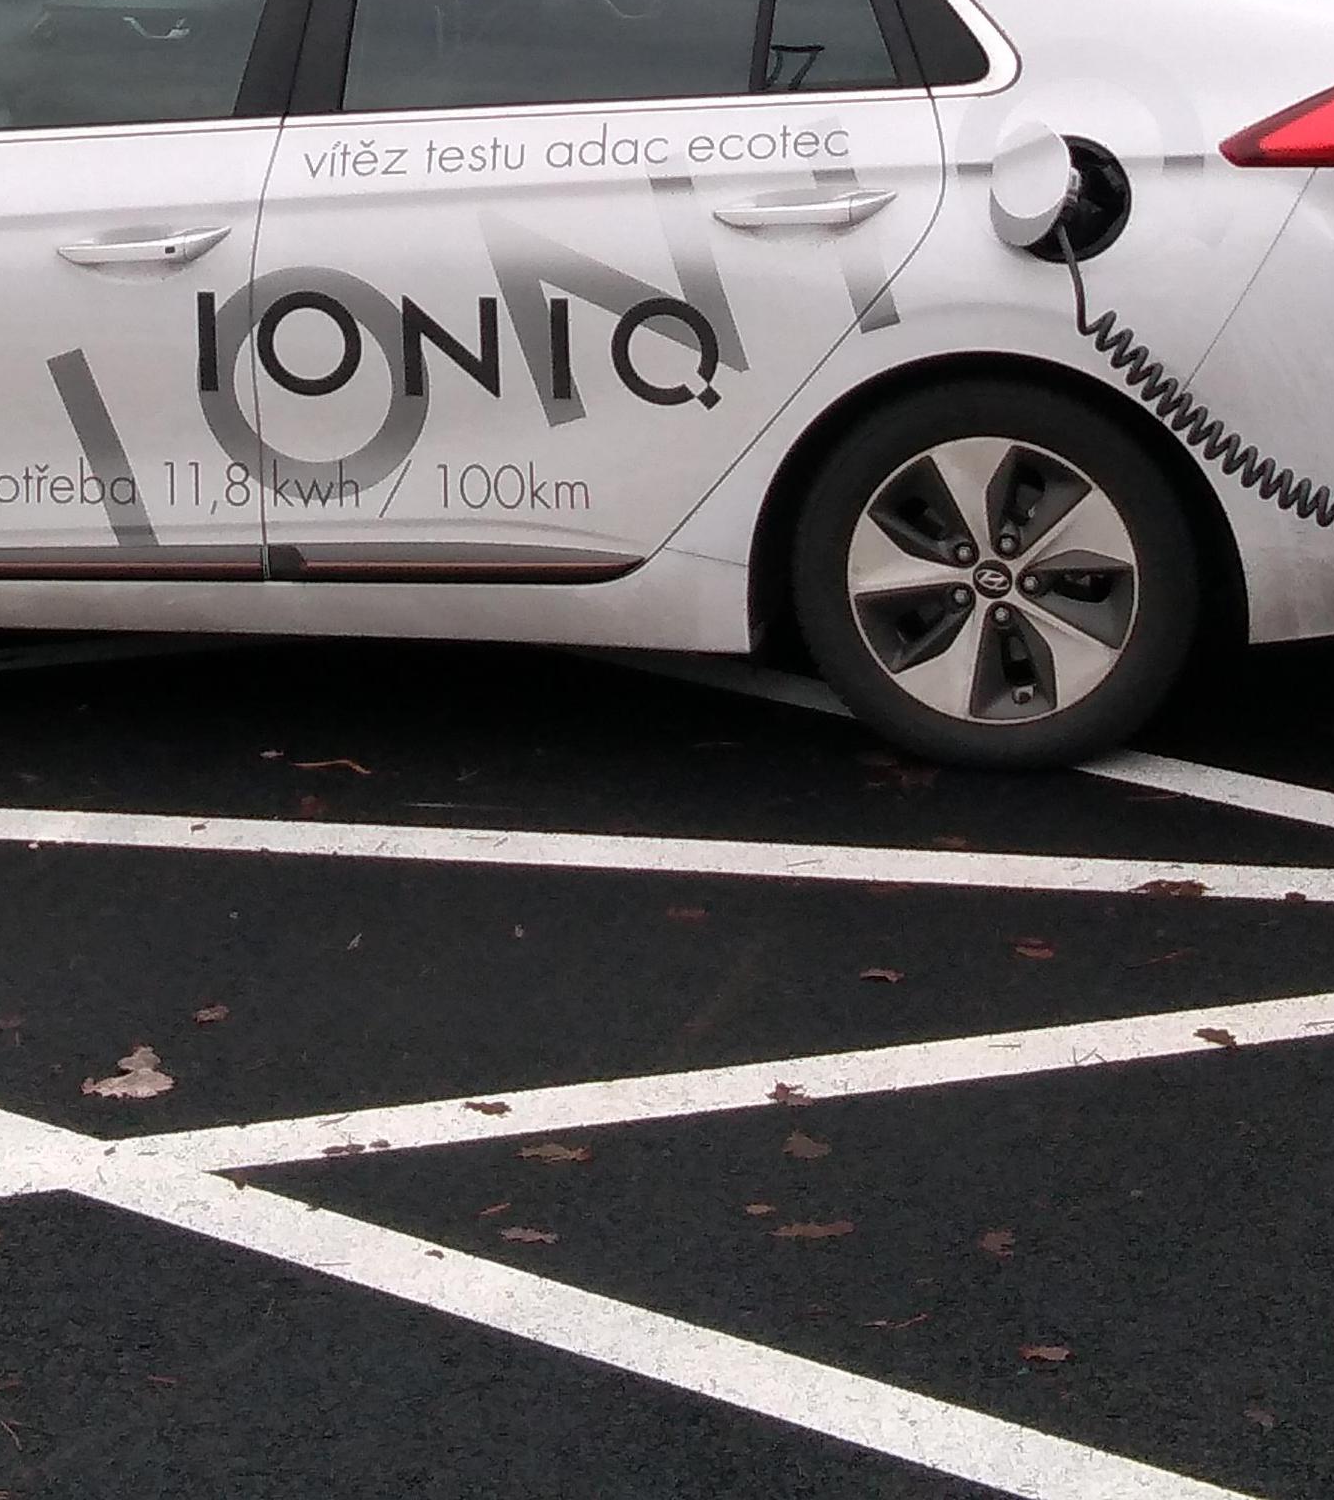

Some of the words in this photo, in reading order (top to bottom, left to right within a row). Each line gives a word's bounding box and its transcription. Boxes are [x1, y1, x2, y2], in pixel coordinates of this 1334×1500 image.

[303, 139, 408, 179] vítěz
[424, 137, 526, 174] testu
[546, 122, 669, 167] adac
[686, 125, 851, 164] ecotec
[196, 289, 723, 411] IONIQ
[164, 460, 253, 515] 11,8
[272, 458, 361, 509] kwh
[378, 458, 413, 519] /
[435, 460, 592, 511] 100km
